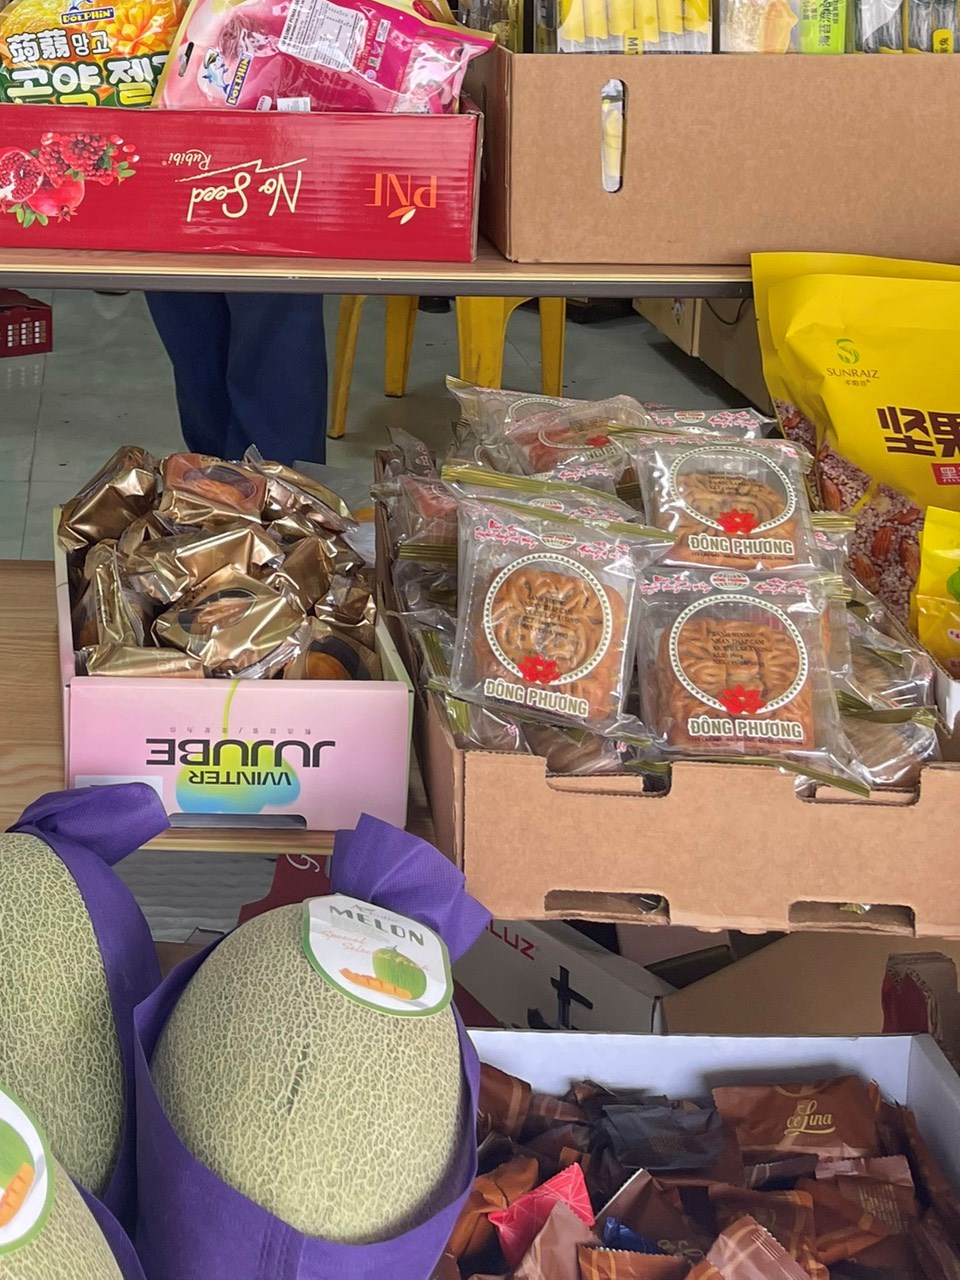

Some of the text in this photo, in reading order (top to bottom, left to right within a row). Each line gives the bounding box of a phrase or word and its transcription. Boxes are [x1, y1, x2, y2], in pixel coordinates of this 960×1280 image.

[71, 30, 111, 57] 망고
[168, 149, 211, 170] Rubibi
[187, 169, 302, 223] No Seed
[826, 367, 880, 380] SUNRAIZ
[690, 533, 794, 555] ĐÔNG PHƯƠNG
[485, 679, 588, 717] ĐÔNG PHƯƠNG
[689, 716, 803, 739] ĐÔNG PHƯƠNG
[146, 738, 336, 768] JUJUBE
[189, 770, 292, 786] WINTER
[330, 905, 425, 946] MELON
[486, 919, 535, 960] LUZ
